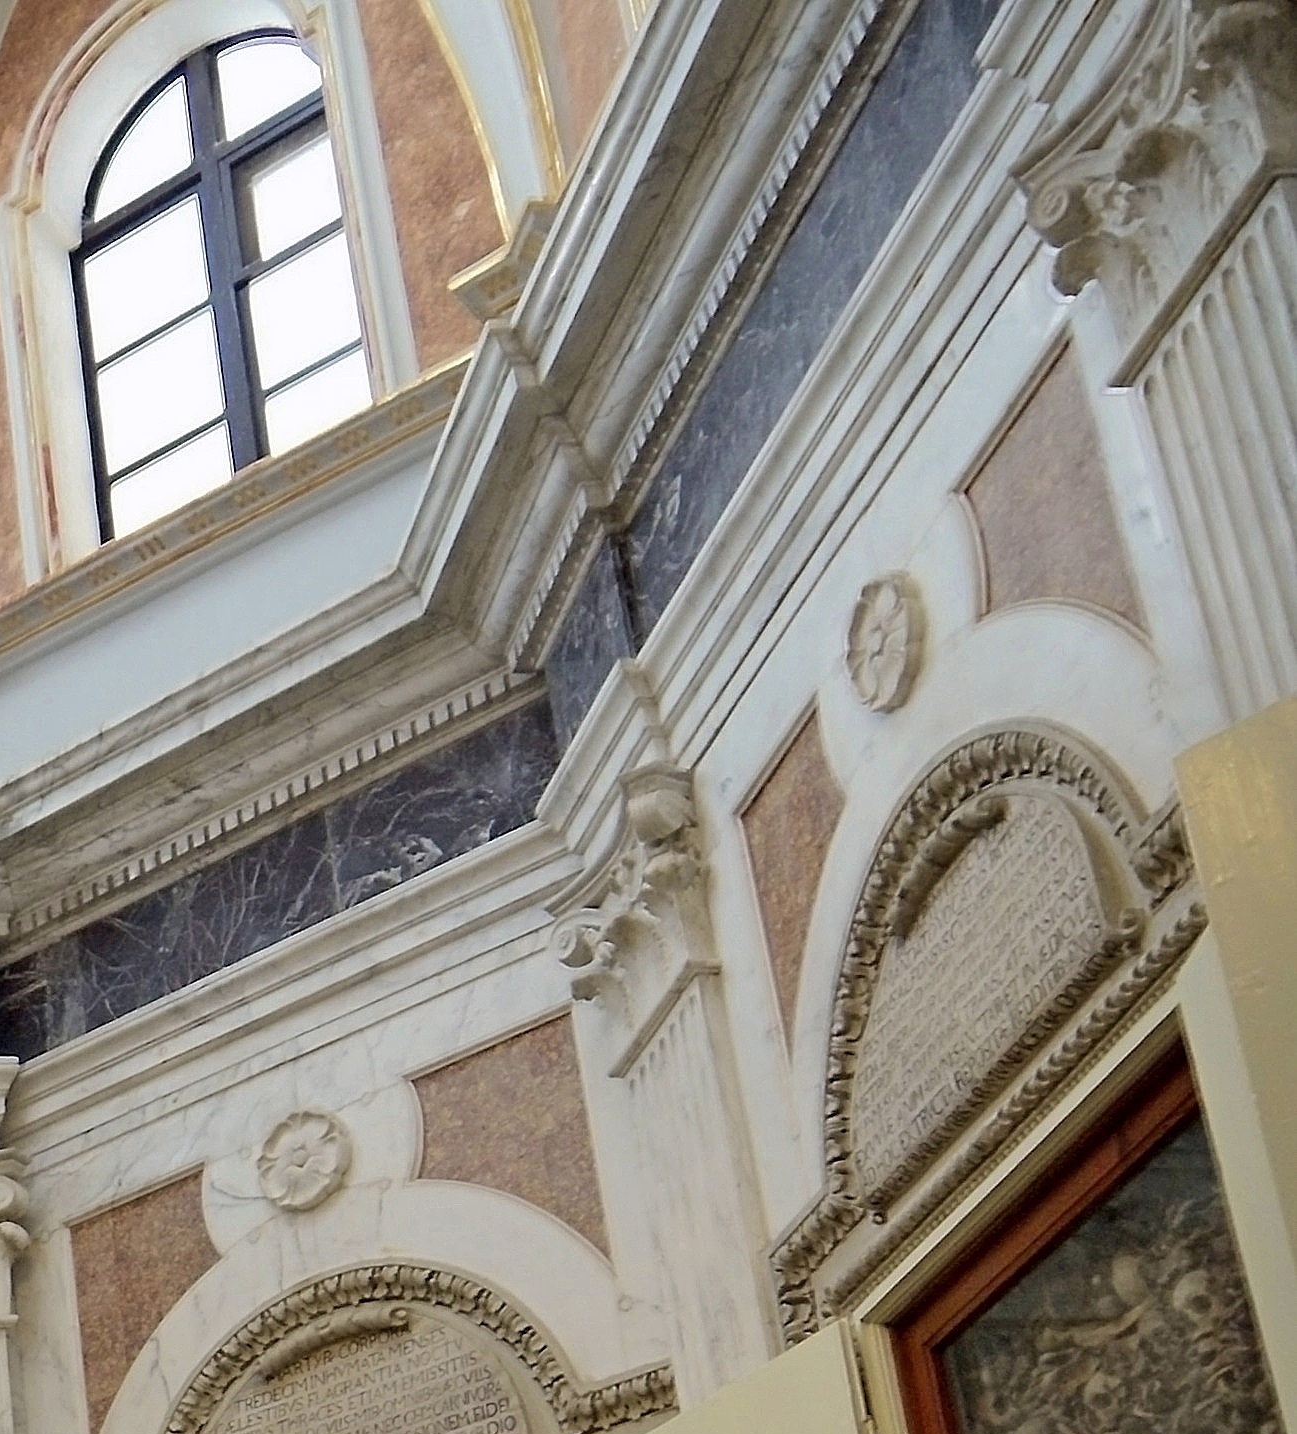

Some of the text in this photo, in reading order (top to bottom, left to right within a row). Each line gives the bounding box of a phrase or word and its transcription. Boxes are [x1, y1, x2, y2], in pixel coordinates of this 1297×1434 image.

[388, 1326, 444, 1359] MENSES
[308, 1361, 402, 1406] FLAGRANTIA
[407, 1335, 462, 1370] NOCTV
[348, 1380, 396, 1409] ETIAM
